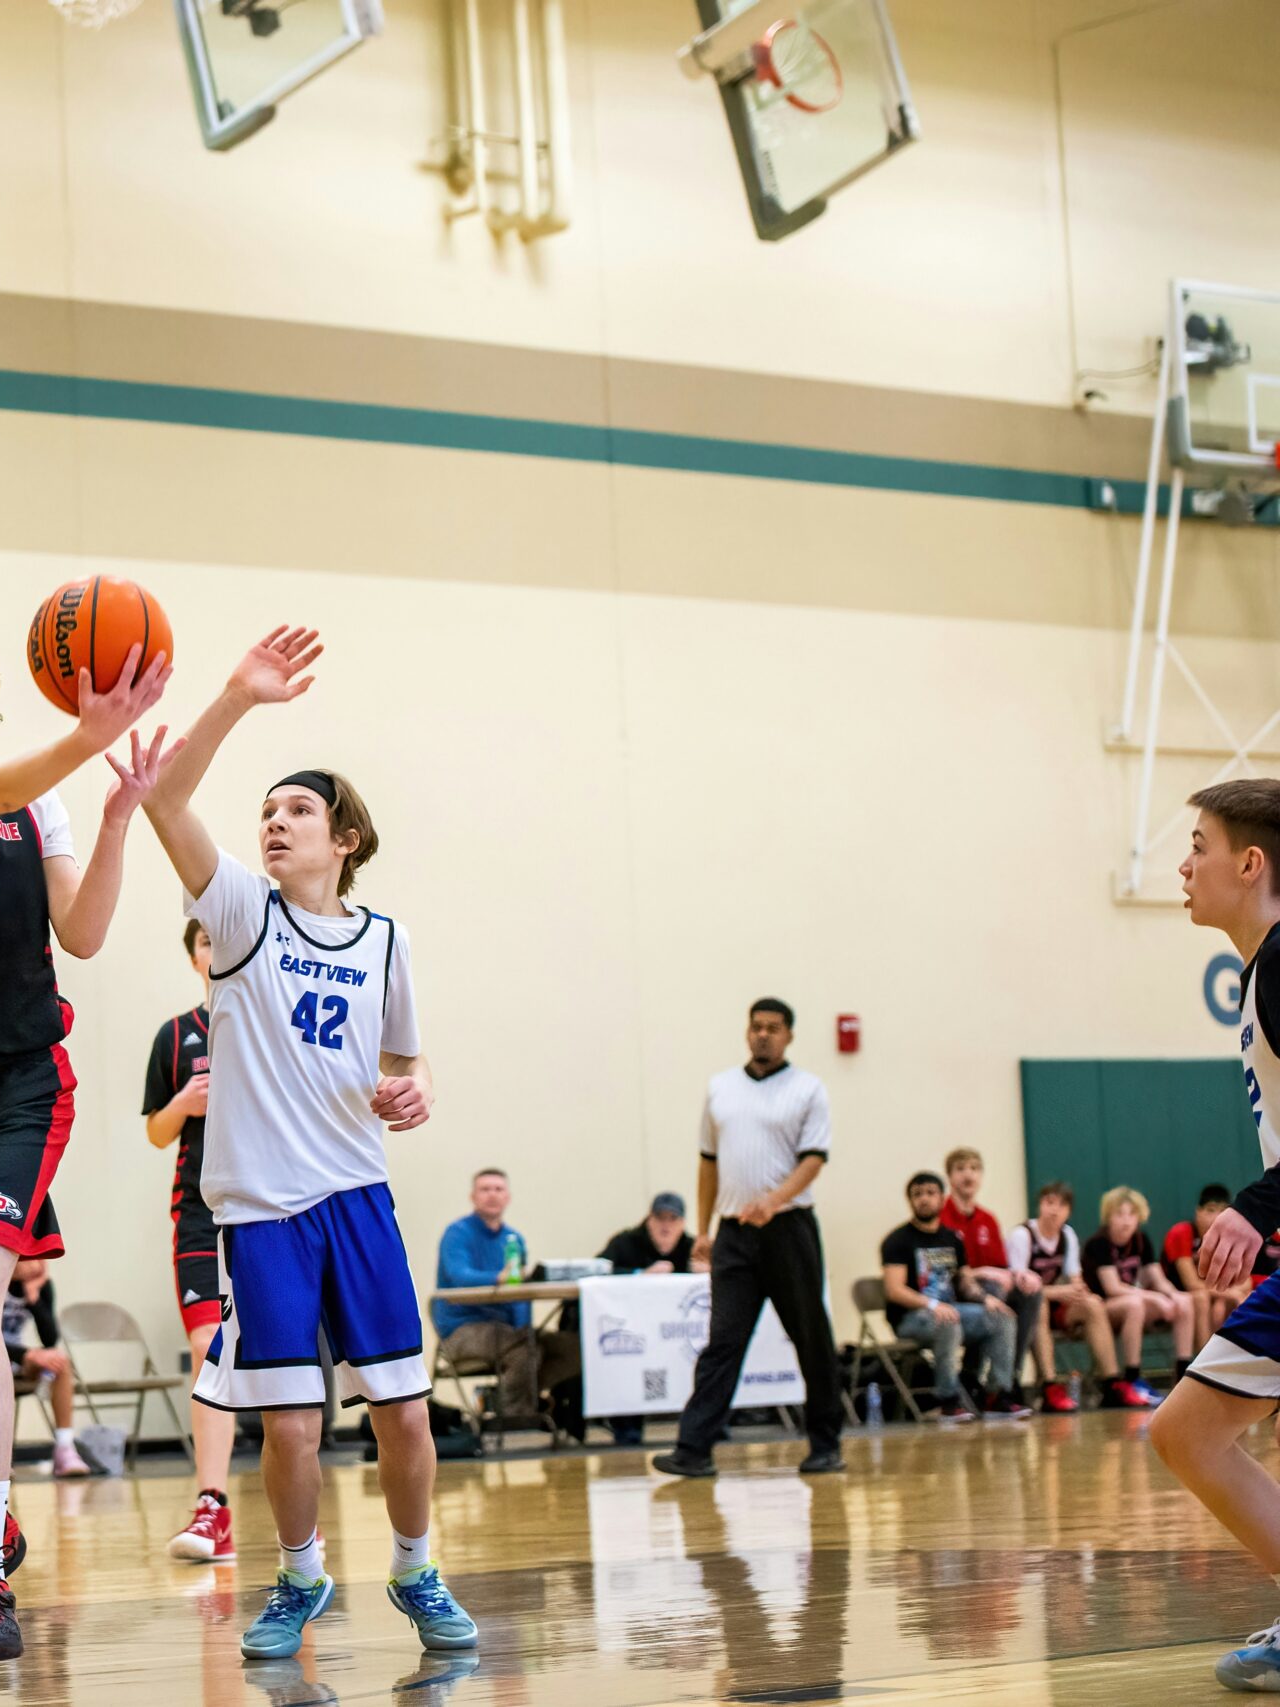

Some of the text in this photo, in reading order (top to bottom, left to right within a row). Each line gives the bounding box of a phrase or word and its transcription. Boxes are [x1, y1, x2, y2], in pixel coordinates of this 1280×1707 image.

[280, 954, 368, 987] EASTVIEW
[1204, 953, 1245, 1026] G
[291, 991, 349, 1050] 42
